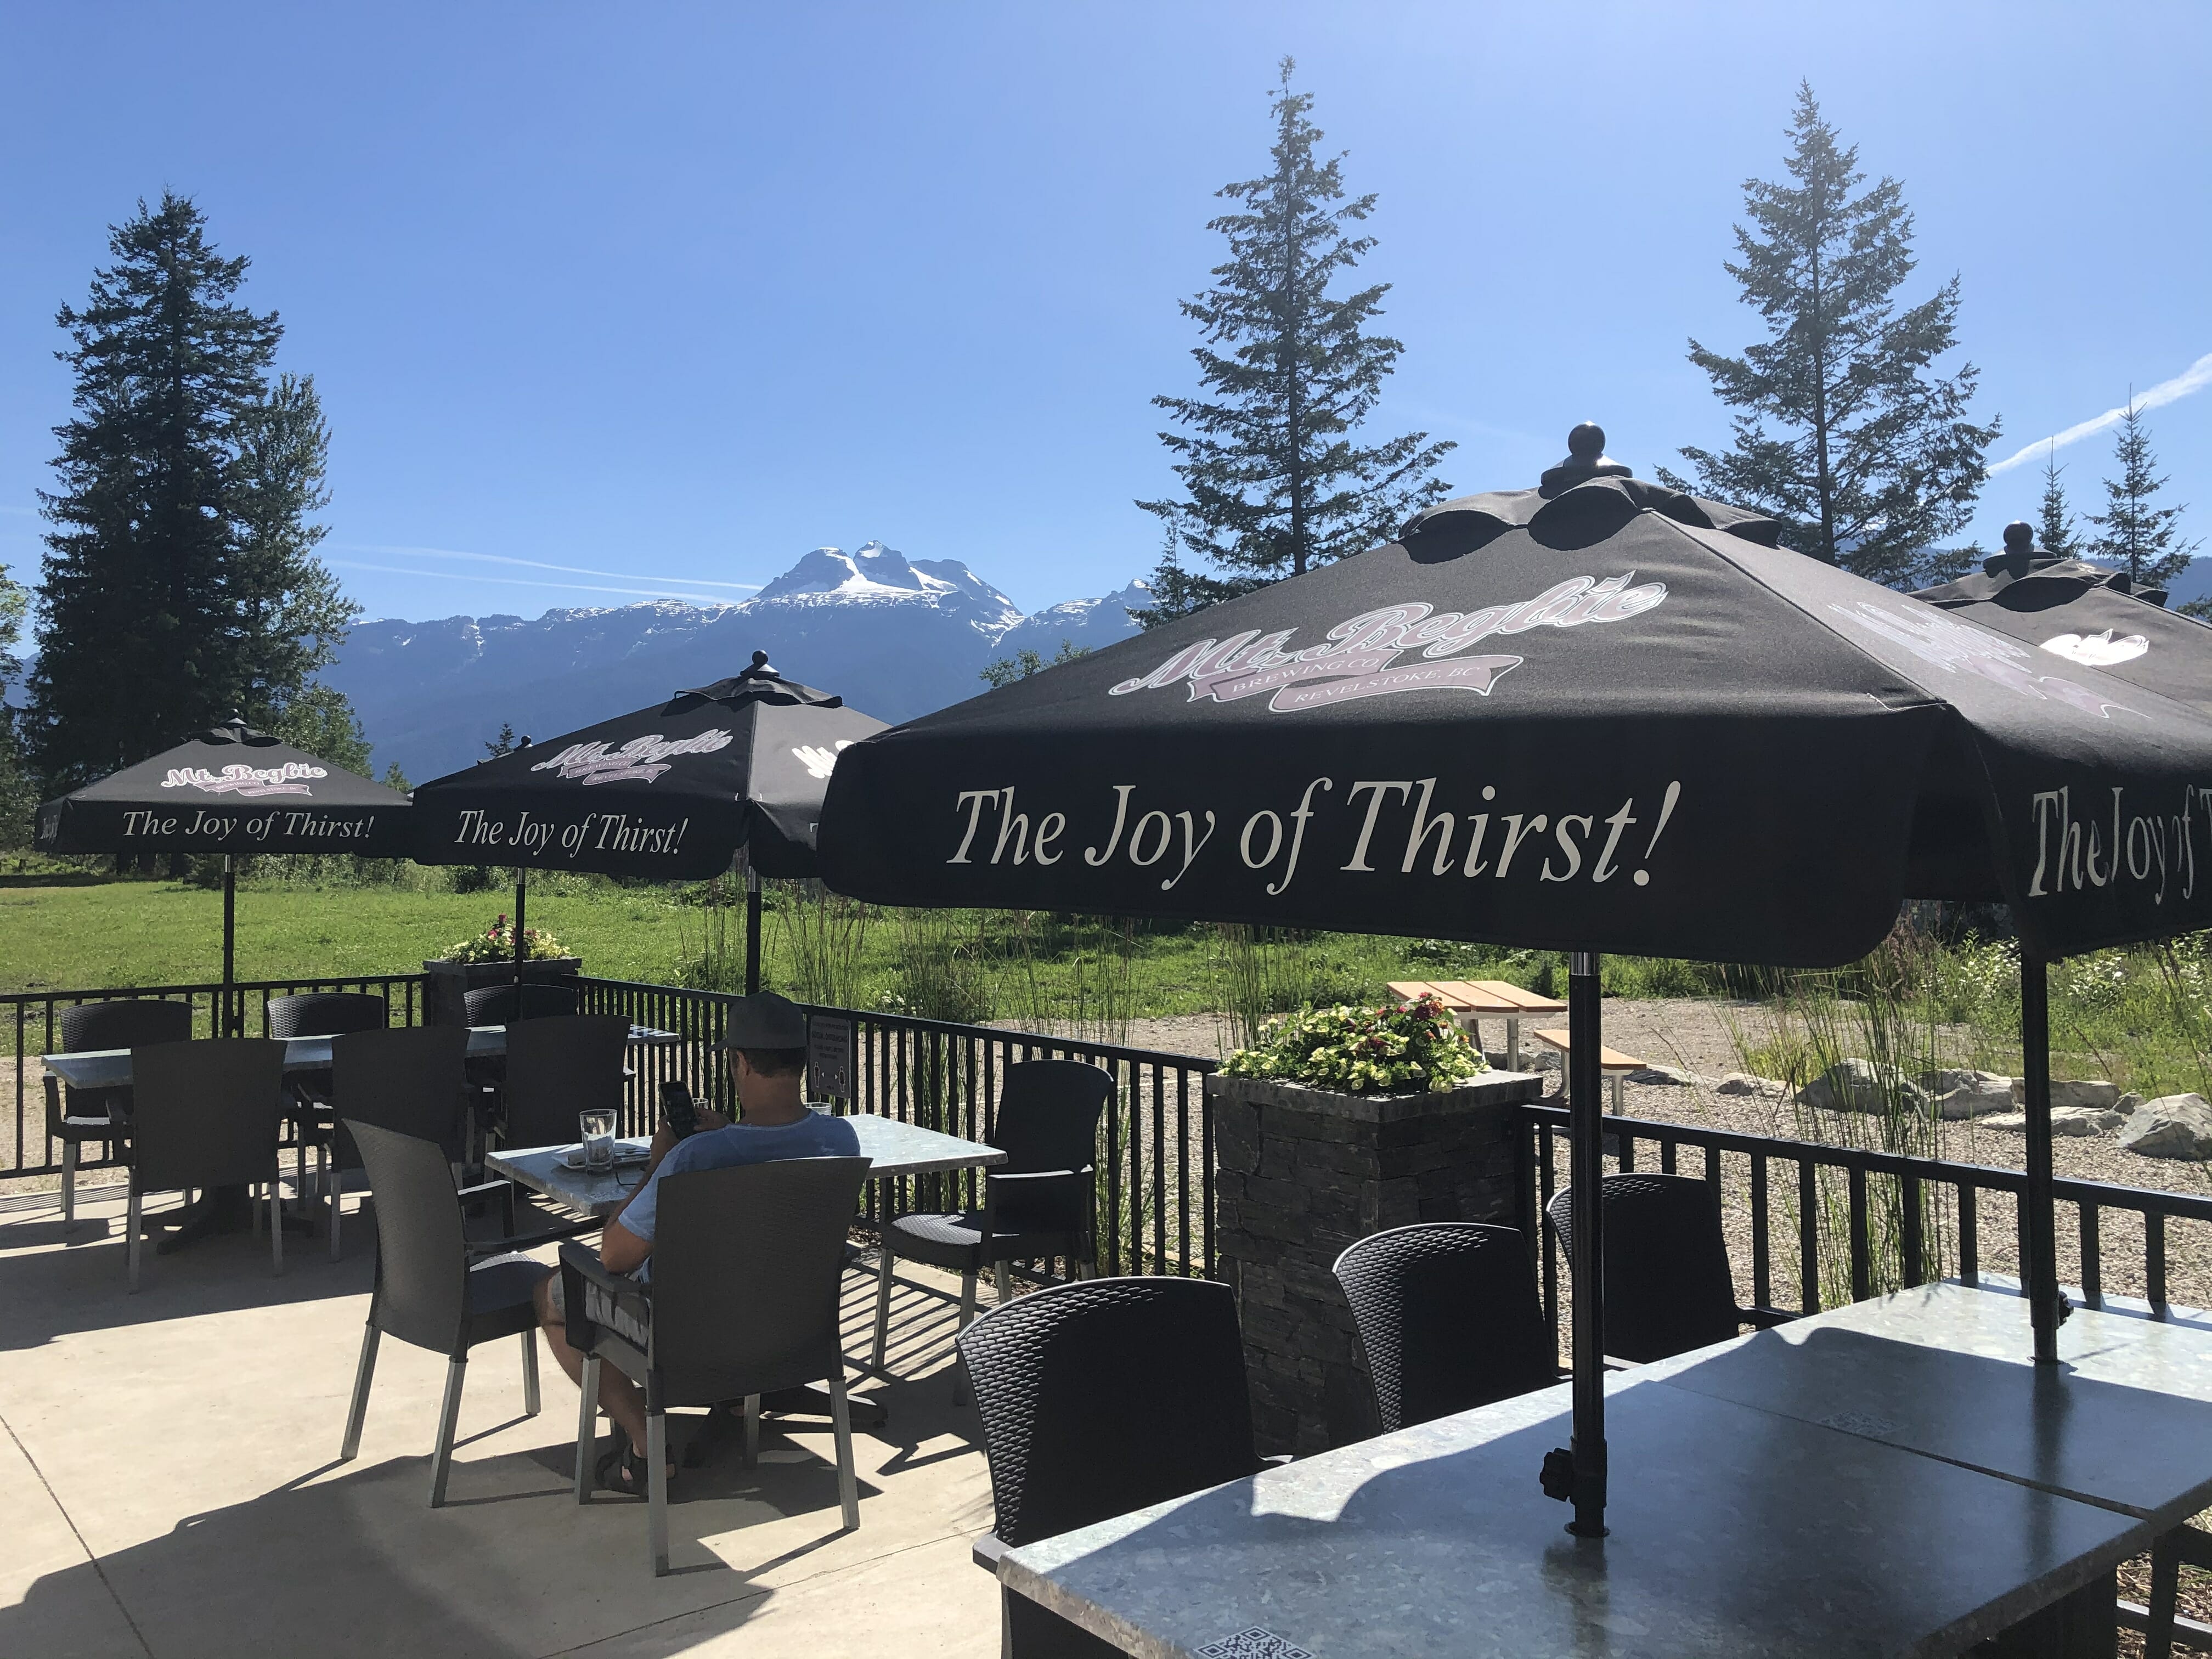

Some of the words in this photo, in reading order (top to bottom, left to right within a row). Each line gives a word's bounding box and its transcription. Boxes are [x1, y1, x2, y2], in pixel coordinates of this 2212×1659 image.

[1297, 570, 1668, 658] Begbie
[1232, 659, 1344, 693] BREWING
[1347, 658, 1378, 668] CO.
[1294, 669, 1441, 703] REVELSTOKE,
[1448, 667, 1481, 678] BC
[221, 762, 328, 783] Begbie
[123, 810, 177, 836] The
[185, 810, 238, 842] Joy
[246, 811, 280, 842] of
[283, 812, 375, 838] Thirst!
[454, 809, 504, 844] The
[509, 811, 555, 856] Joy
[562, 812, 597, 858] of
[594, 814, 689, 855] Thirst!
[946, 785, 1066, 866] The
[1084, 784, 1216, 891] Joy
[1240, 777, 1333, 895] of
[1341, 777, 1682, 887] Thirst!
[2028, 785, 2107, 897] The
[2106, 787, 2165, 905] Joy
